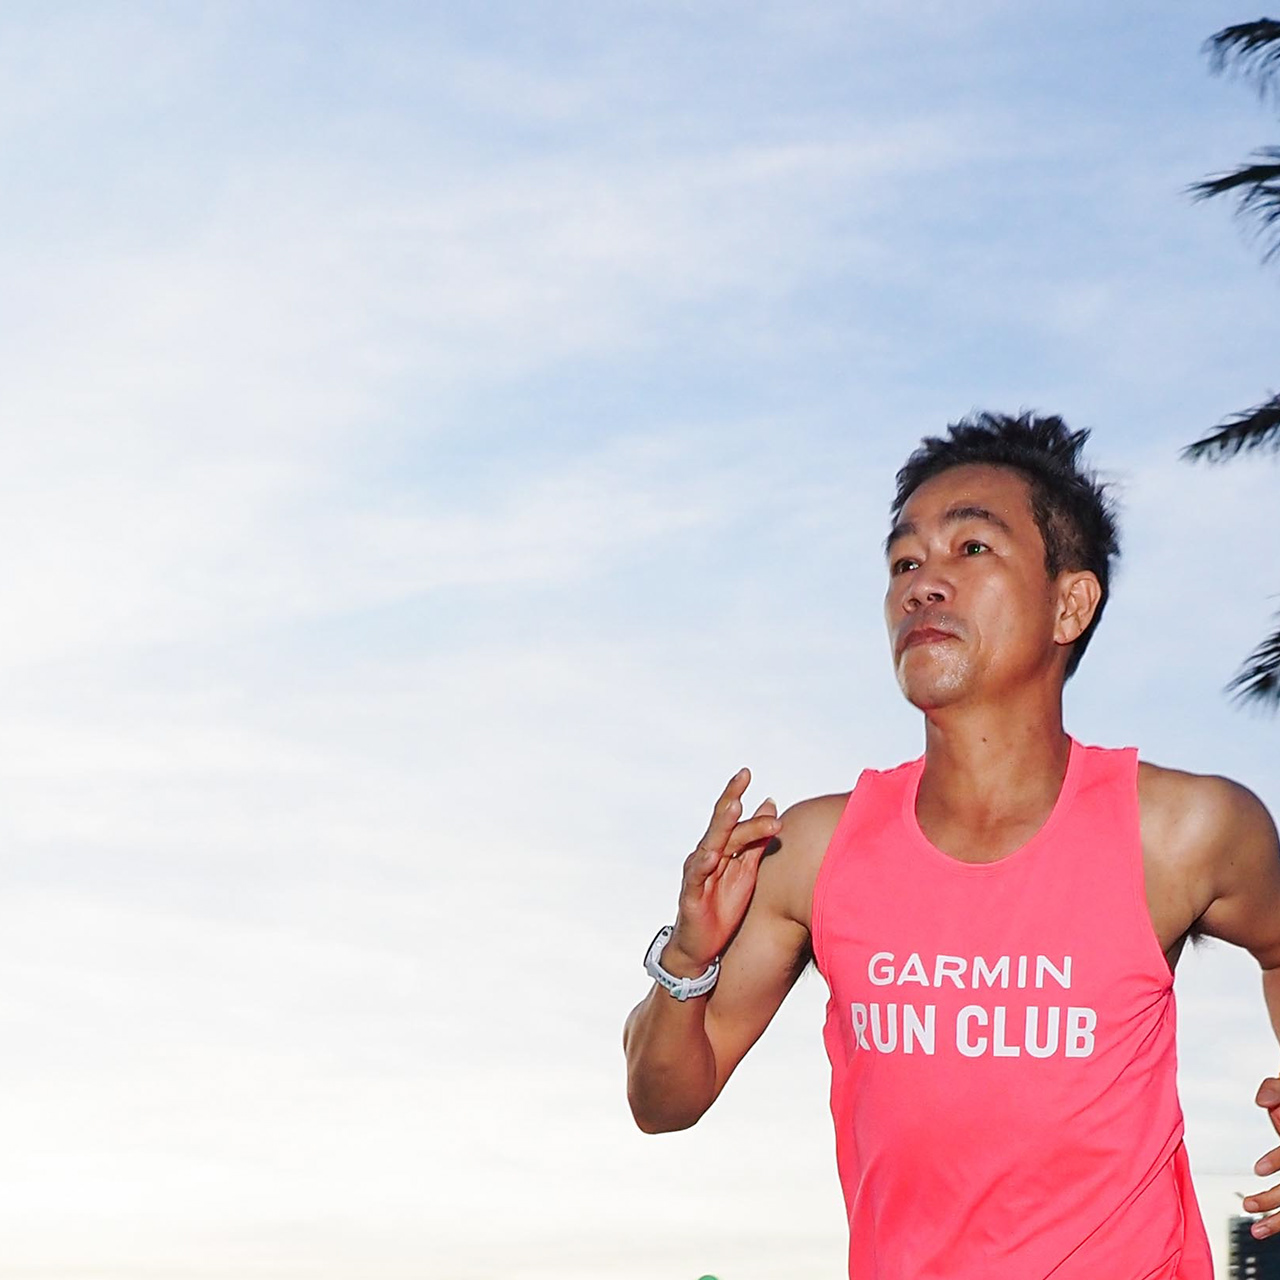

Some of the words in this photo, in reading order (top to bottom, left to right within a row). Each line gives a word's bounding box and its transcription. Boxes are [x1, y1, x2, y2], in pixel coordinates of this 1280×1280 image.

[868, 951, 1072, 989] GARMIN
[851, 1002, 936, 1055] RUN
[956, 1004, 1097, 1058] CLUB
